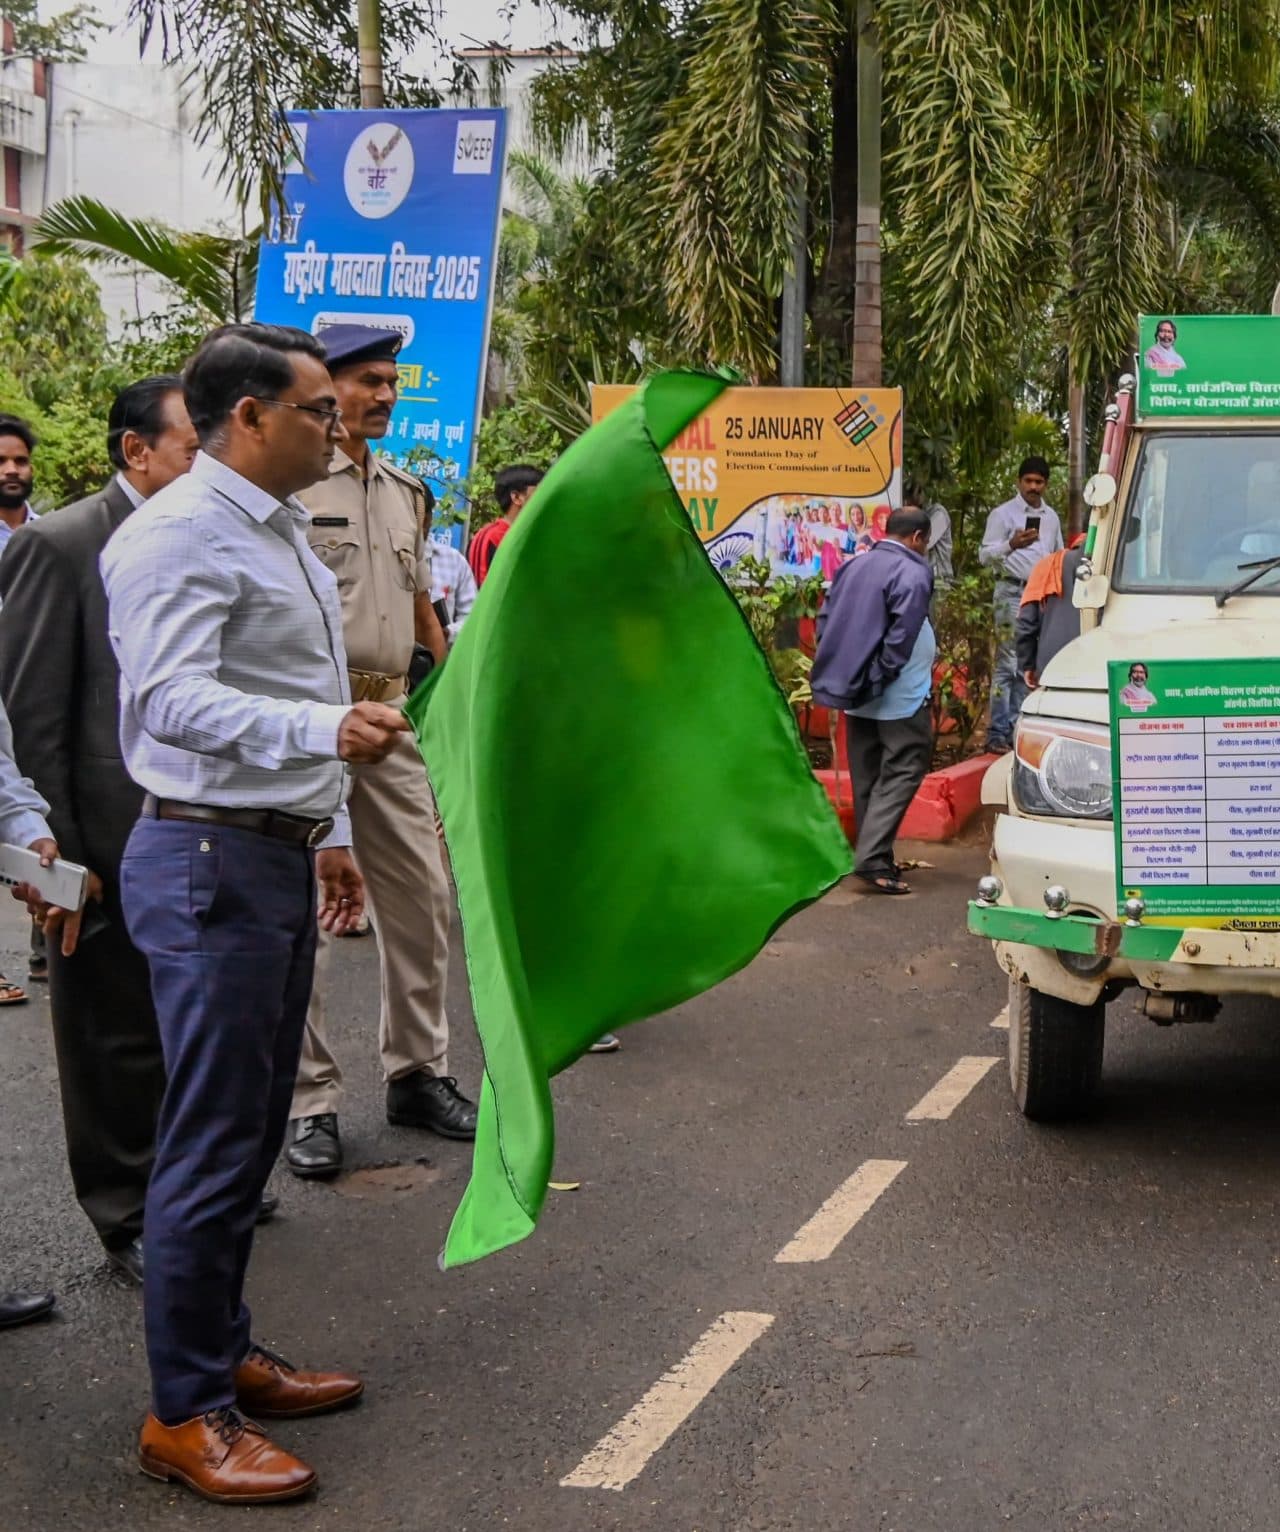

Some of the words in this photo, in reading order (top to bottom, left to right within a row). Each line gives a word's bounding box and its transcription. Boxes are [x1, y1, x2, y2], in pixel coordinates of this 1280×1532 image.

[457, 133, 492, 161] SWEEP
[283, 239, 329, 304] राष्ट्रीय
[331, 252, 386, 297] मतदाता
[388, 241, 481, 301] दिवस-2025
[412, 418, 440, 441] अपनी
[444, 421, 465, 448] पूर्ण
[725, 417, 743, 441] 25
[748, 417, 824, 441] JANUARY
[726, 449, 782, 459] Foundation
[785, 450, 805, 461] Day
[808, 450, 818, 460] of
[726, 462, 766, 472] Election
[768, 464, 828, 473] Commission
[832, 464, 842, 473] of
[845, 465, 871, 474] India
[687, 497, 719, 532] AY
